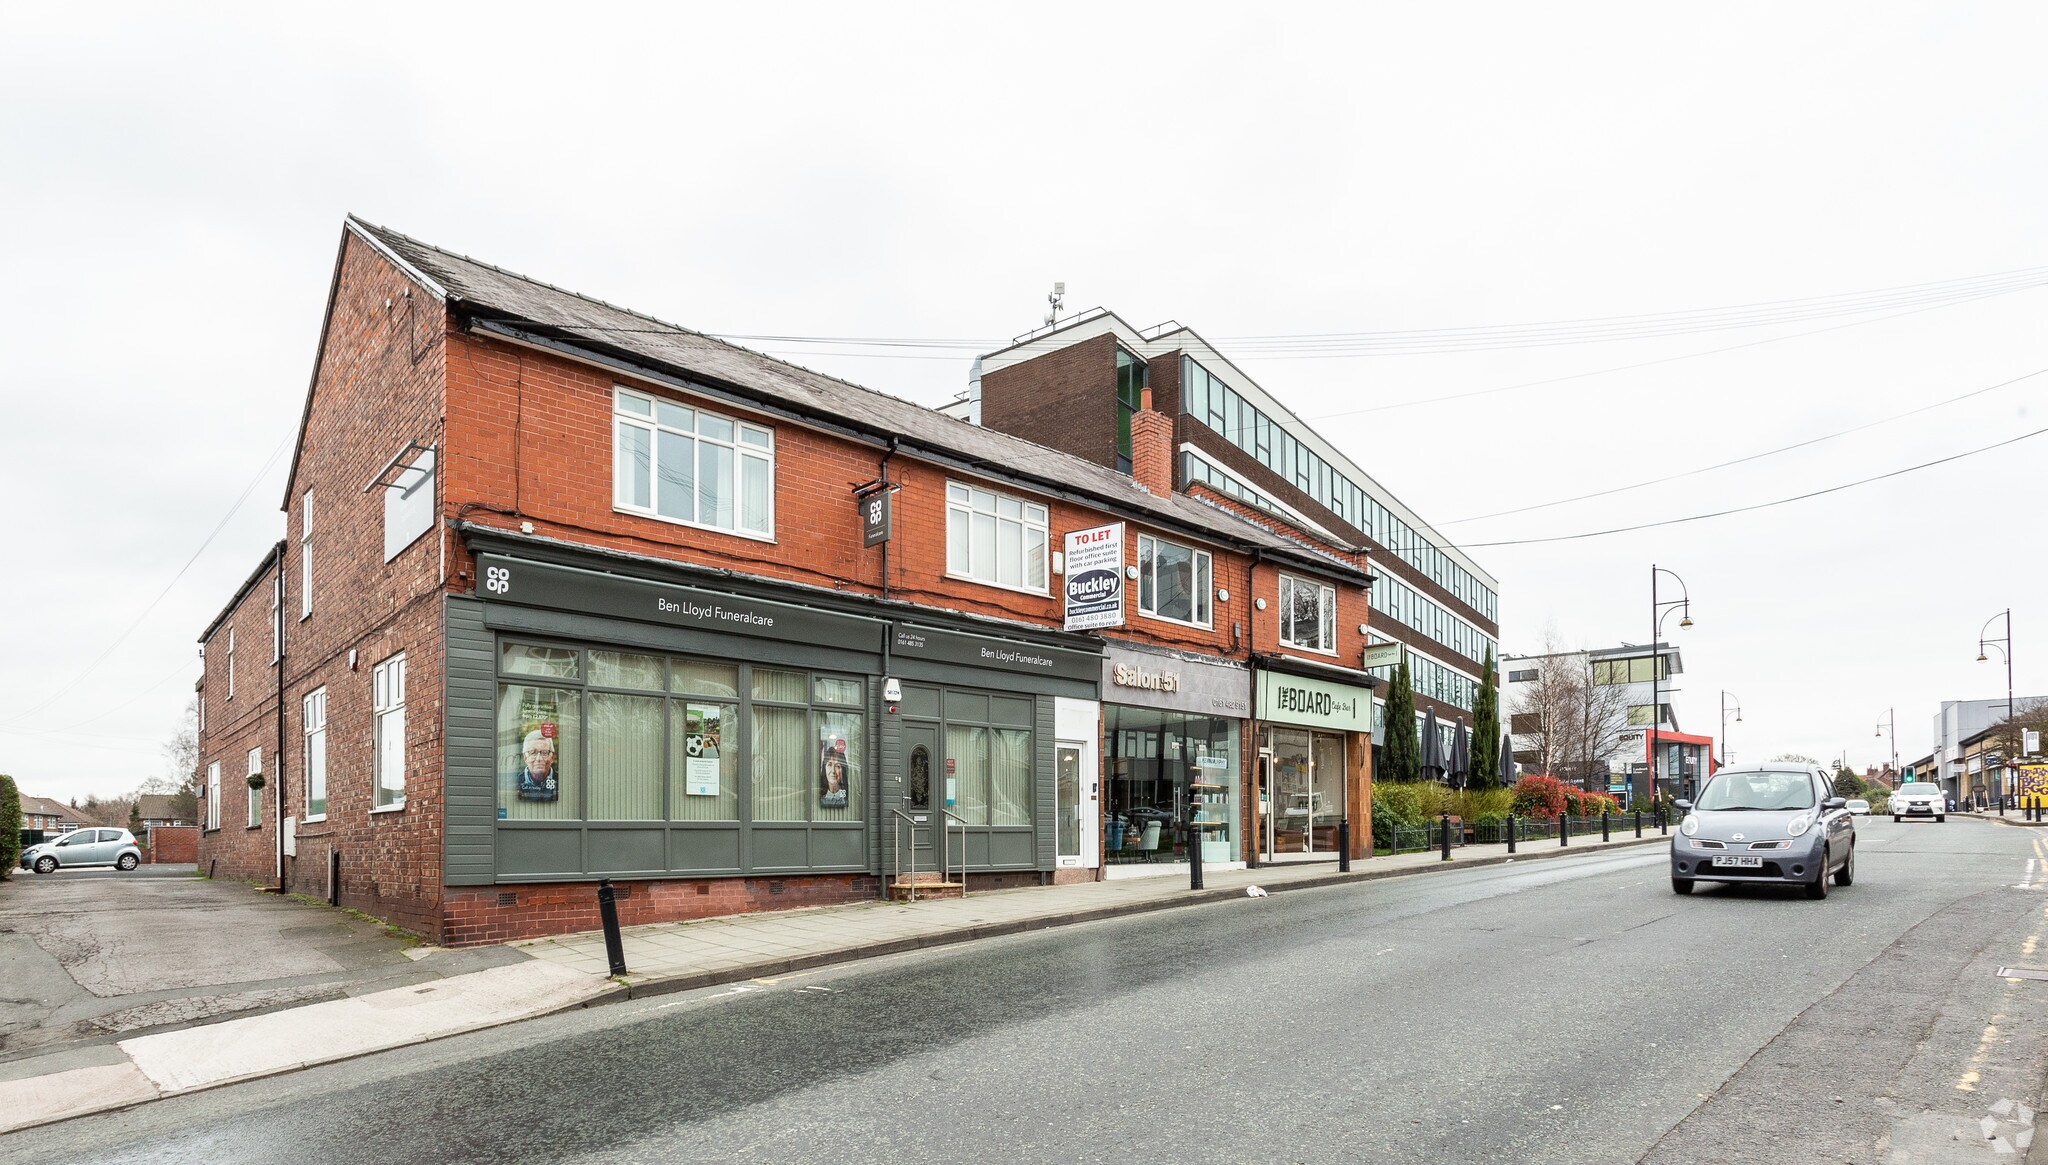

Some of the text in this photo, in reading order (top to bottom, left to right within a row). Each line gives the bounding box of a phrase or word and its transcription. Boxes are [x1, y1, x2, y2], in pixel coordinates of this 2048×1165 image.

[1075, 530, 1110, 545] TO LET
[1069, 545, 1104, 556] Refurbished
[1094, 557, 1117, 565] parking
[1070, 576, 1117, 596] Buckley
[1080, 592, 1106, 600] Commercial
[658, 598, 774, 626] Ben Lloyd Funeralcare
[1069, 602, 1117, 614] buckleycommercial.co.uk
[981, 648, 1052, 666] Ben Lloyd Funeralcare
[1114, 662, 1162, 690] Salon
[1289, 688, 1331, 715] BOARD
[1714, 857, 1738, 865] PJ57
